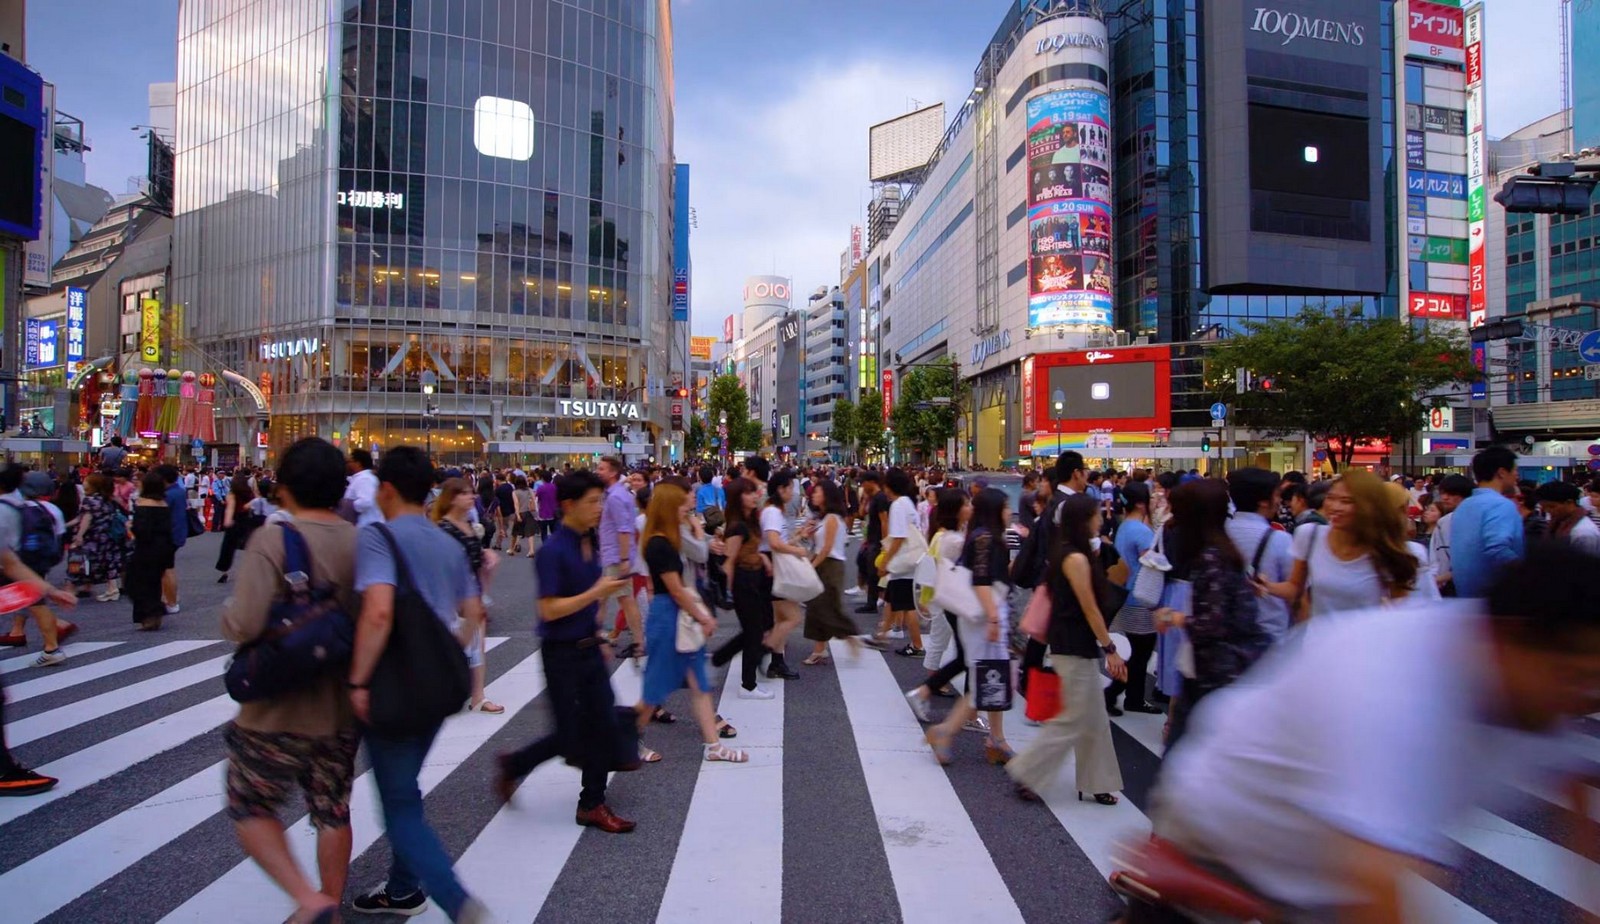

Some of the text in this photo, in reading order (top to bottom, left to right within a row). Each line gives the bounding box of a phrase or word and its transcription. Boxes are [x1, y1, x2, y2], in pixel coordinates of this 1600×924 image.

[1410, 12, 1462, 36] アイフル
[1430, 46, 1443, 56] 8F
[1469, 53, 1479, 82] アイフル
[1053, 112, 1074, 121] 8.19
[1030, 143, 1060, 156] HARRIS
[1409, 176, 1463, 195] レオパレス21
[1053, 202, 1075, 212] 8.20
[1472, 194, 1481, 218] レイク
[1428, 244, 1450, 256] レイク
[1472, 265, 1482, 291] アコム
[675, 268, 687, 310] SEIBU
[1414, 298, 1451, 313] アコム
[69, 291, 84, 356] 洋服の青山
[1085, 351, 1114, 363] Glico
[560, 401, 639, 418] TSUTAYA
